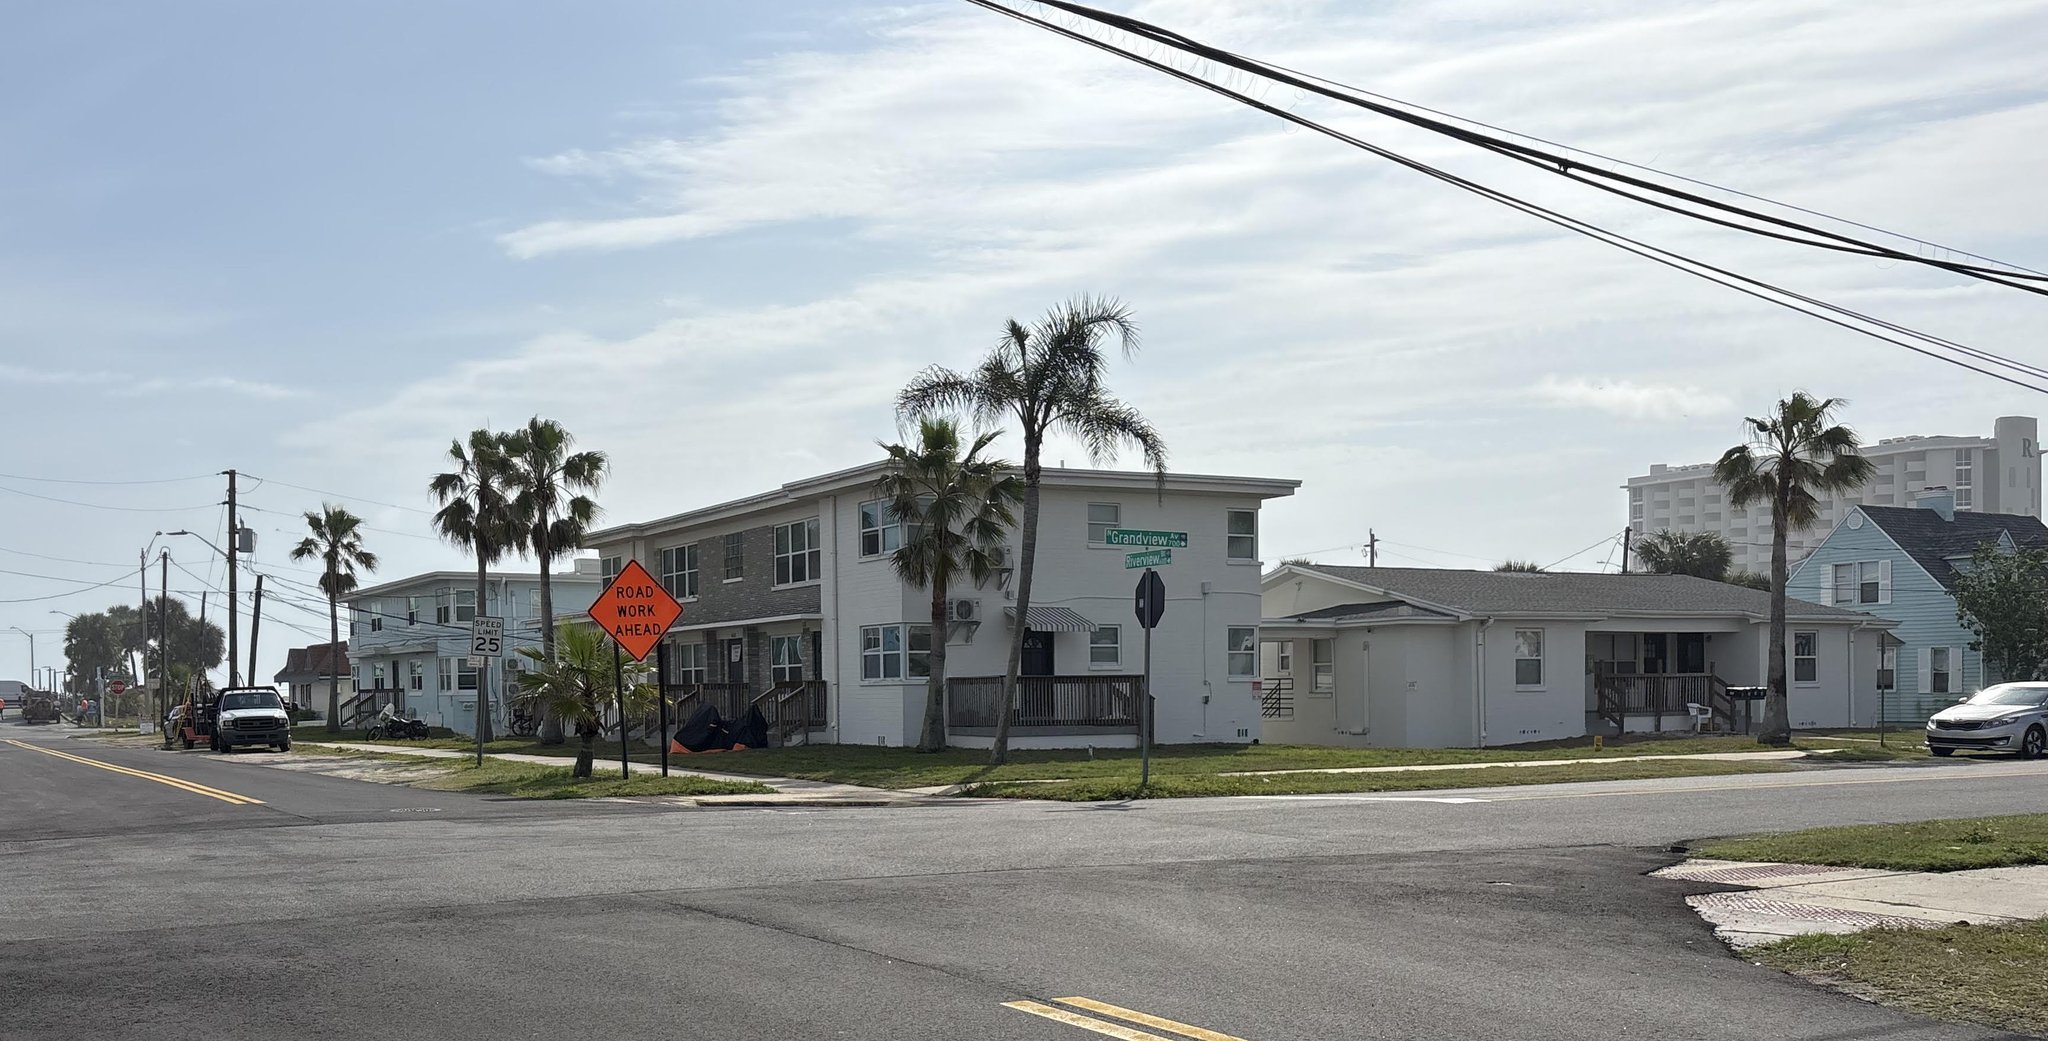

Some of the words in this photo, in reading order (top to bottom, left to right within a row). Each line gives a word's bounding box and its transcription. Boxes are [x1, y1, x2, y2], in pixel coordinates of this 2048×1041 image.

[2022, 438, 2034, 458] R
[1112, 531, 1168, 545] Grandview
[1126, 554, 1160, 568] Riverview
[616, 586, 654, 599] ROAD
[617, 604, 656, 617] WORK
[475, 620, 502, 628] SPEED
[615, 623, 661, 636] AHEAD
[475, 637, 500, 652] 25
